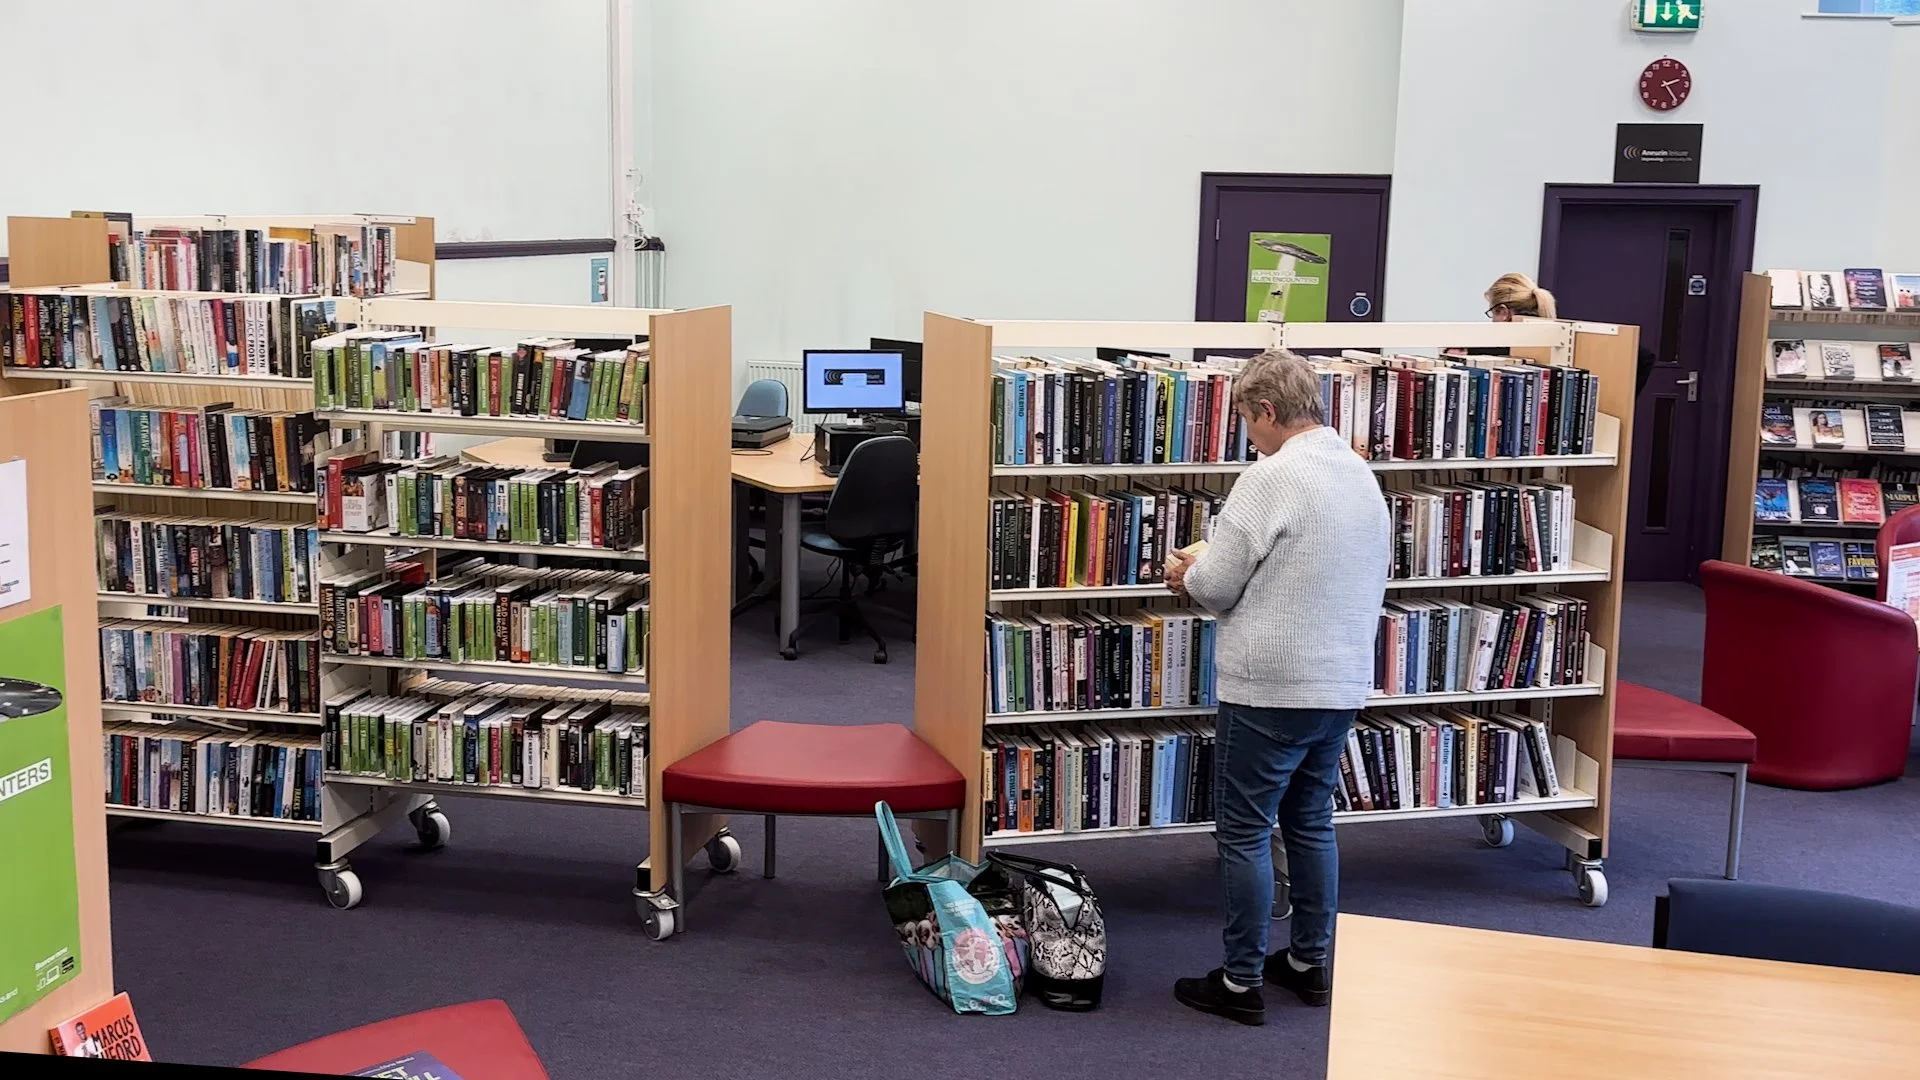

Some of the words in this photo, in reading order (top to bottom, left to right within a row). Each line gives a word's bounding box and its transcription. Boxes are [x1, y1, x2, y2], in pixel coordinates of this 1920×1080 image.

[246, 320, 254, 337] JACK
[1764, 413, 1792, 421] Secrets
[140, 415, 150, 451] HEATWAVE
[1157, 506, 1165, 529] ORIGIN
[190, 547, 199, 567] LEGACY
[1848, 558, 1876, 567] FAVOUR
[326, 588, 334, 622] LAWLESS
[181, 771, 189, 802] MARTIAN
[293, 788, 301, 810] TRACKS
[91, 1015, 135, 1052] MARCUS
